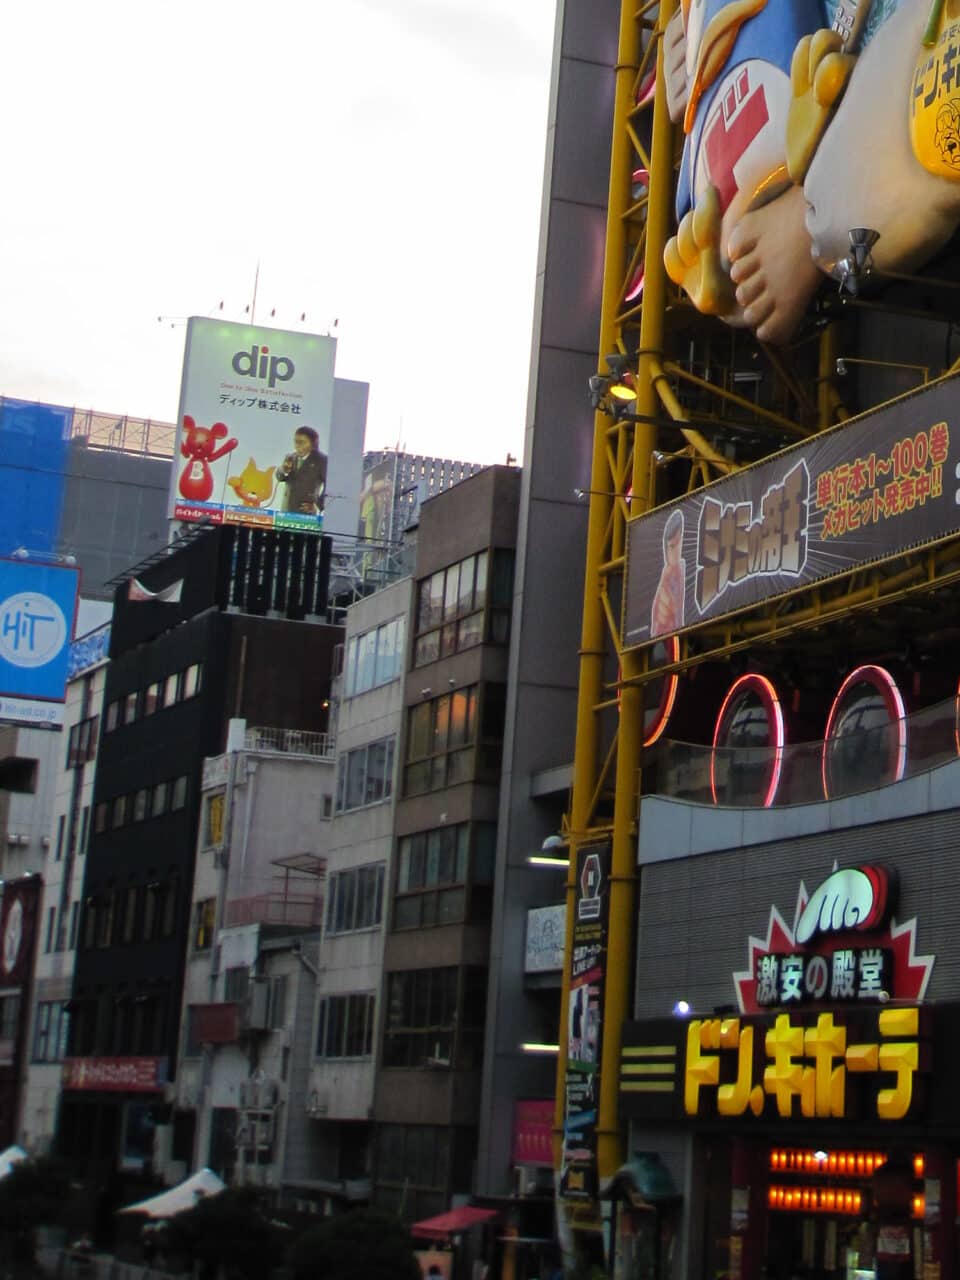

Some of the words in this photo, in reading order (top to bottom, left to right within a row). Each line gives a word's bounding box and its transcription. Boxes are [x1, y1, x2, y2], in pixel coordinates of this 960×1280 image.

[232, 345, 296, 388] dip
[218, 394, 302, 415] ディップ株式会社
[756, 949, 885, 1004] 激安の殿堂
